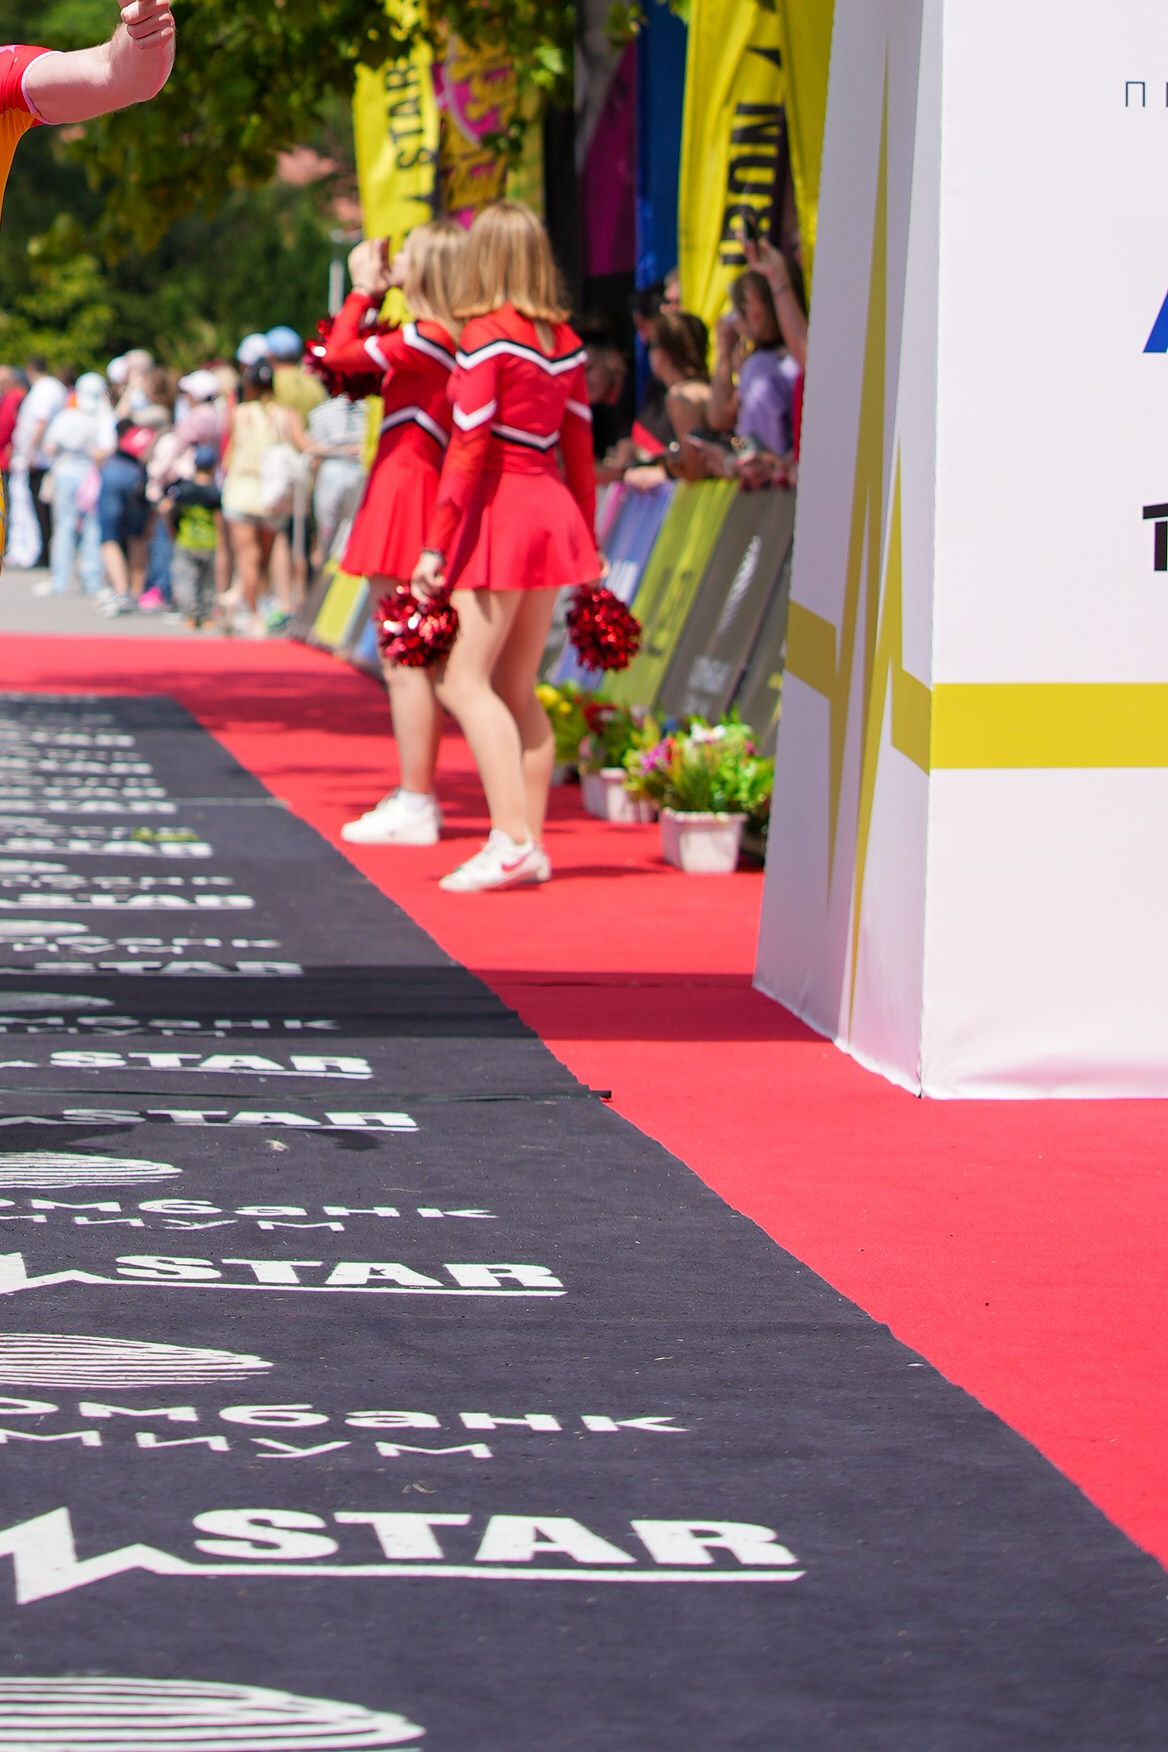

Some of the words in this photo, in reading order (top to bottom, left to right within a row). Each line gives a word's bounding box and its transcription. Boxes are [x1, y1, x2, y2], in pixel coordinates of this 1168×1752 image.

[49, 1050, 373, 1074] STAR
[62, 1108, 418, 1127] STAR
[116, 1254, 565, 1288] STAR
[191, 1508, 800, 1565] STAR
